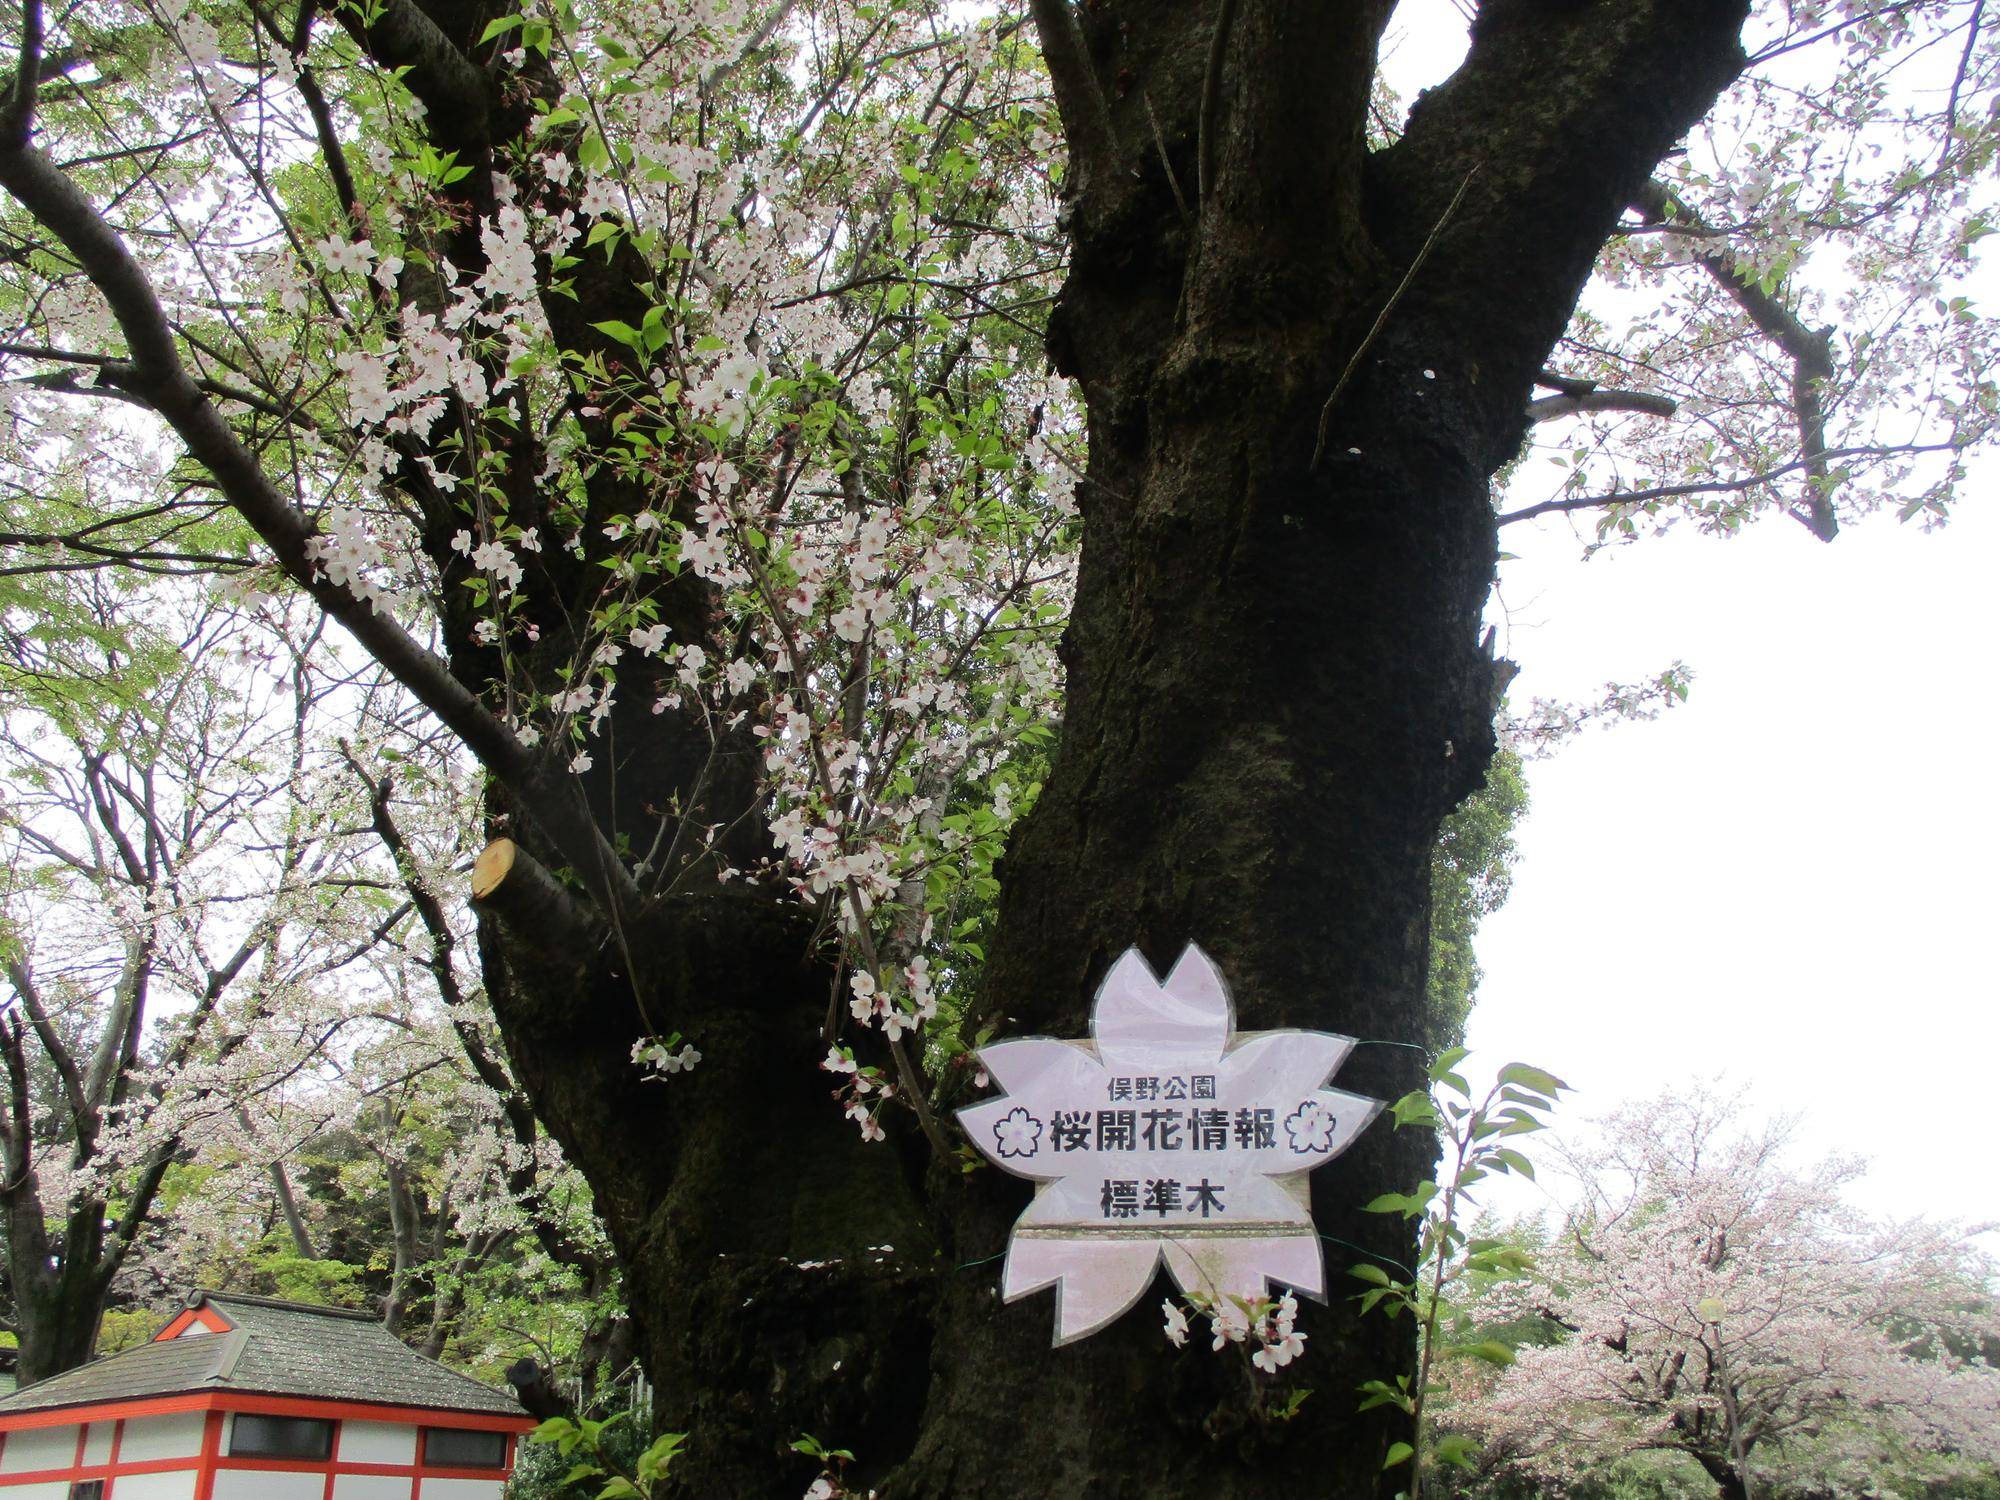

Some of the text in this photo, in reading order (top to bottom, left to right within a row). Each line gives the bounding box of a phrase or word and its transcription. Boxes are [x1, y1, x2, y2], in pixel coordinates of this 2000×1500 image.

[1107, 1075, 1216, 1101] 俣野公園
[1050, 1107, 1277, 1152] 桜開花情報
[1101, 1178, 1226, 1219] 標準木
